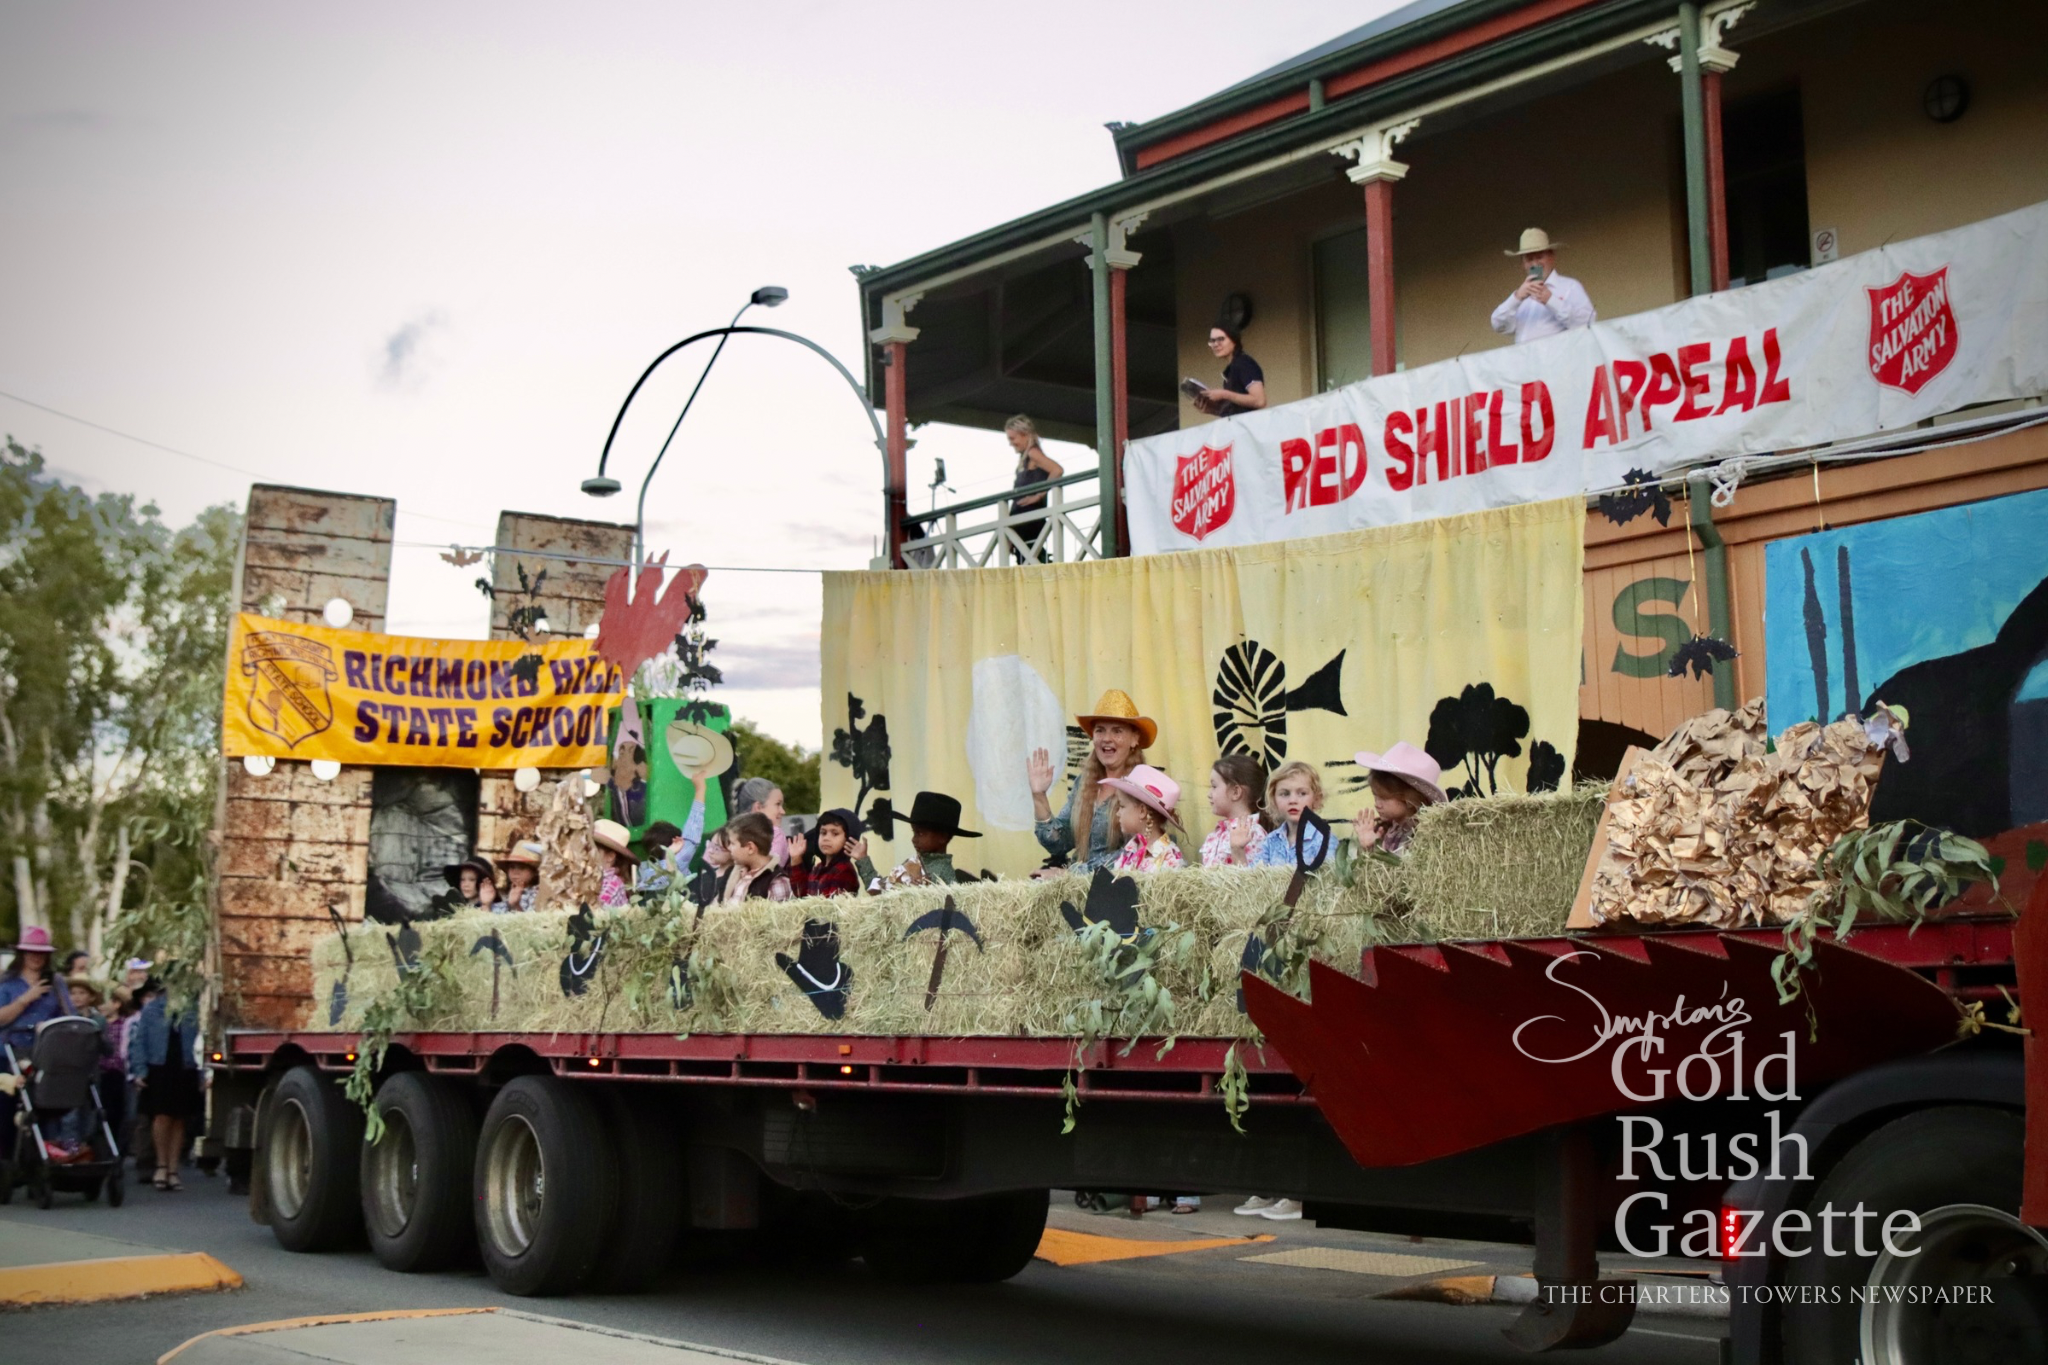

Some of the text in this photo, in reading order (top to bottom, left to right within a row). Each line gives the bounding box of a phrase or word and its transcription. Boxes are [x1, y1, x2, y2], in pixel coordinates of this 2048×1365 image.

[1872, 276, 1946, 374] SALVATION
[1880, 279, 1914, 328] THE
[1899, 314, 1946, 386] ARMY
[1280, 327, 1791, 515] RED SHIELD APPEAL
[1173, 451, 1231, 523] SALVATION
[1181, 450, 1208, 487] THE
[1193, 481, 1229, 534] ARMY
[1580, 577, 1694, 685] S
[264, 662, 321, 726] STATE SCHOOL
[354, 700, 608, 748] STATE SCHOOL
